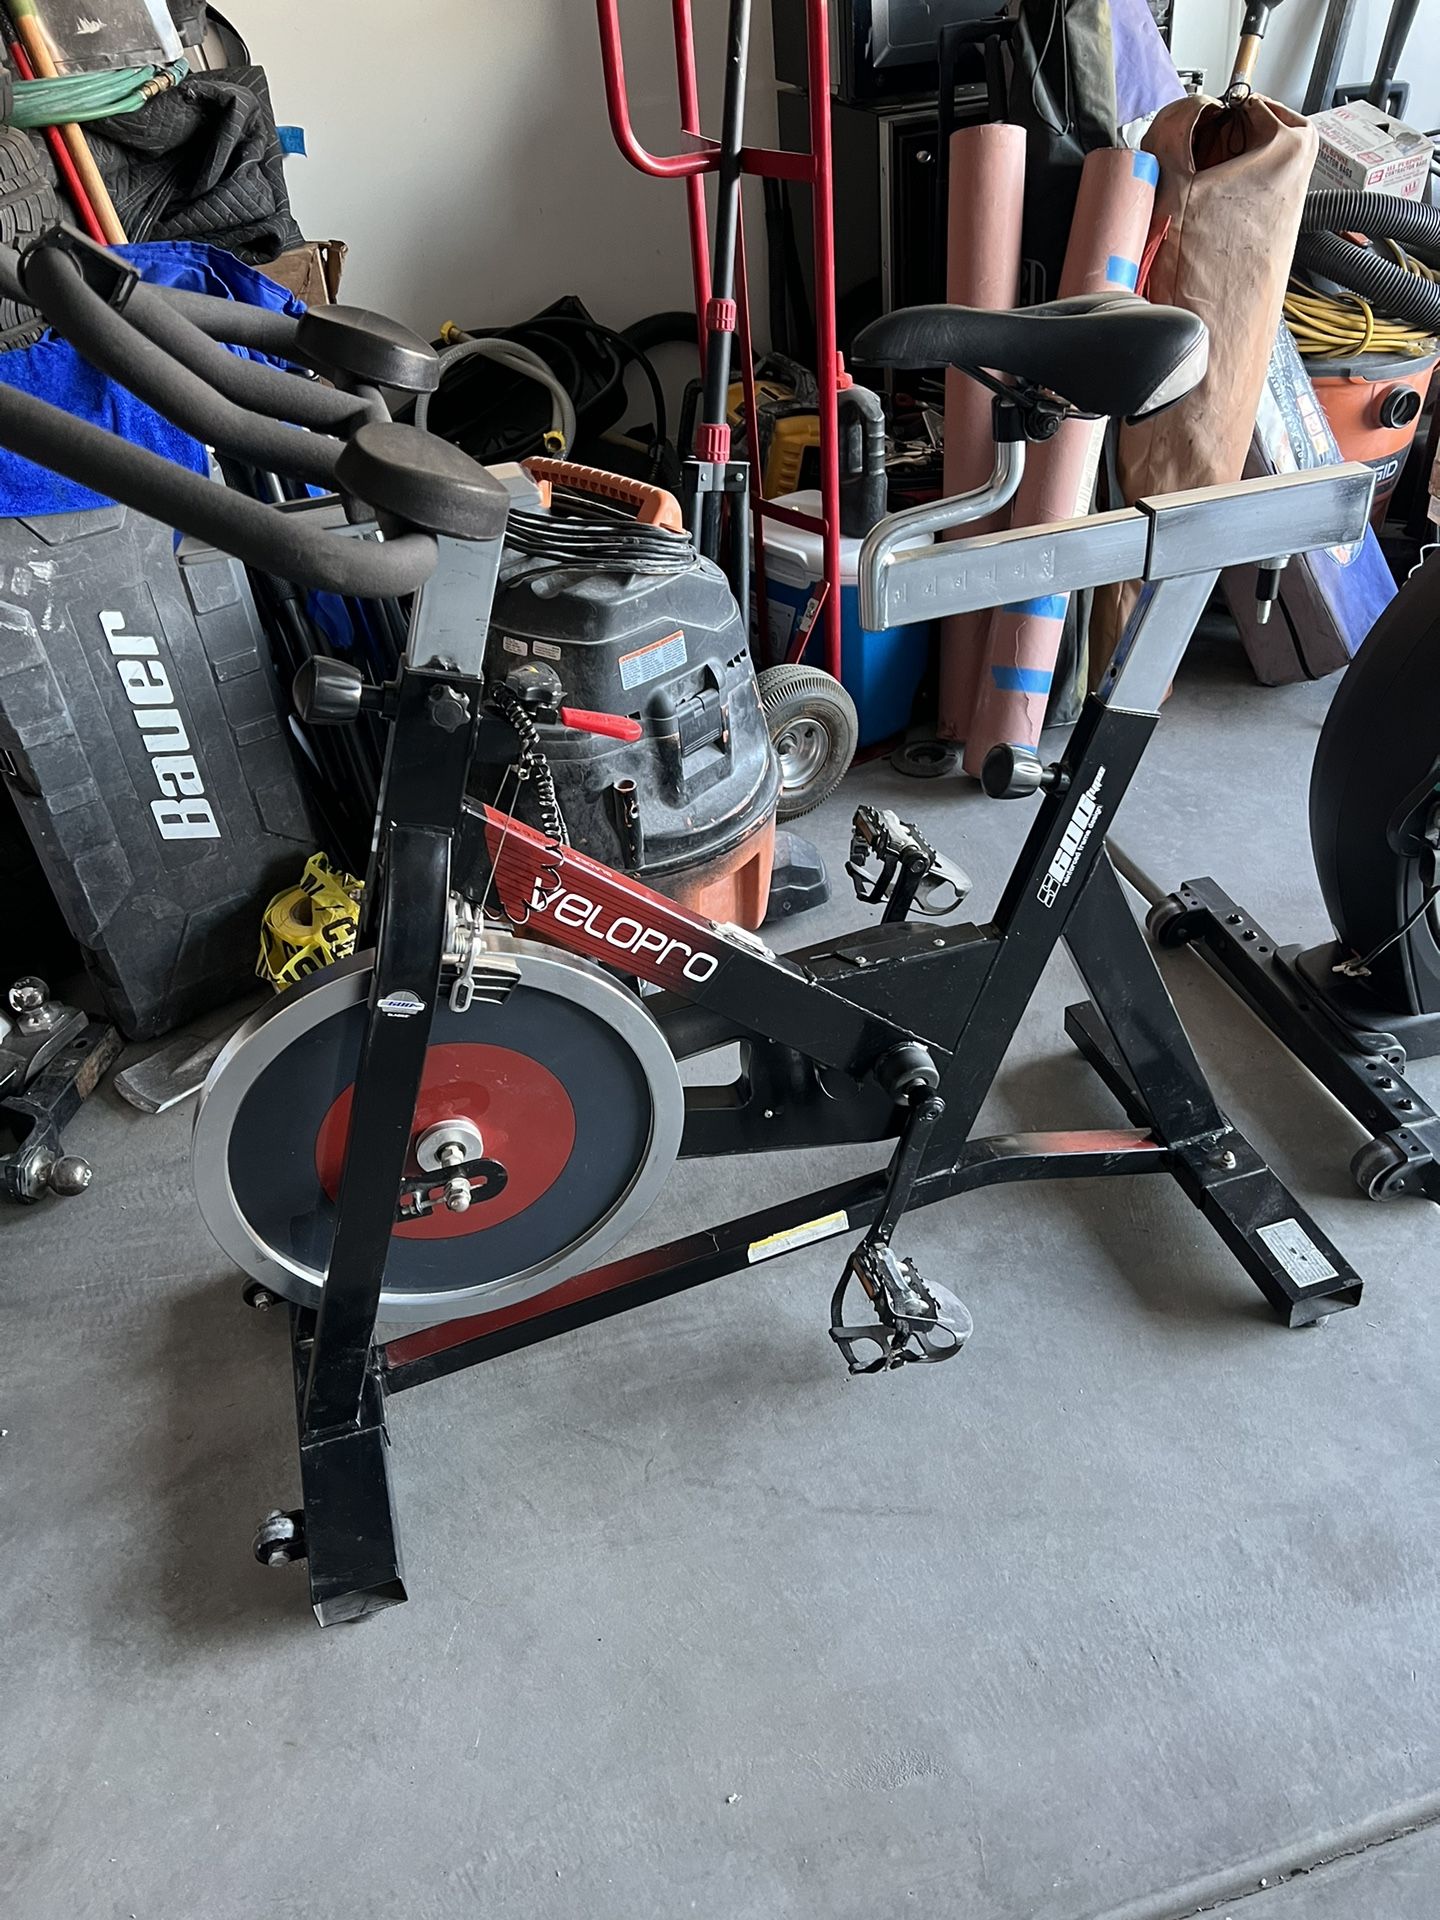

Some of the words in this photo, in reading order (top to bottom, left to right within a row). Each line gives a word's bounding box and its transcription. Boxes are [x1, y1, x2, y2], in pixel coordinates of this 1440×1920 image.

[1374, 459, 1398, 482] GID
[98, 610, 222, 840] Bauer
[1061, 851, 1082, 887] reinforced
[1077, 829, 1092, 851] frame
[1087, 804, 1104, 829] design
